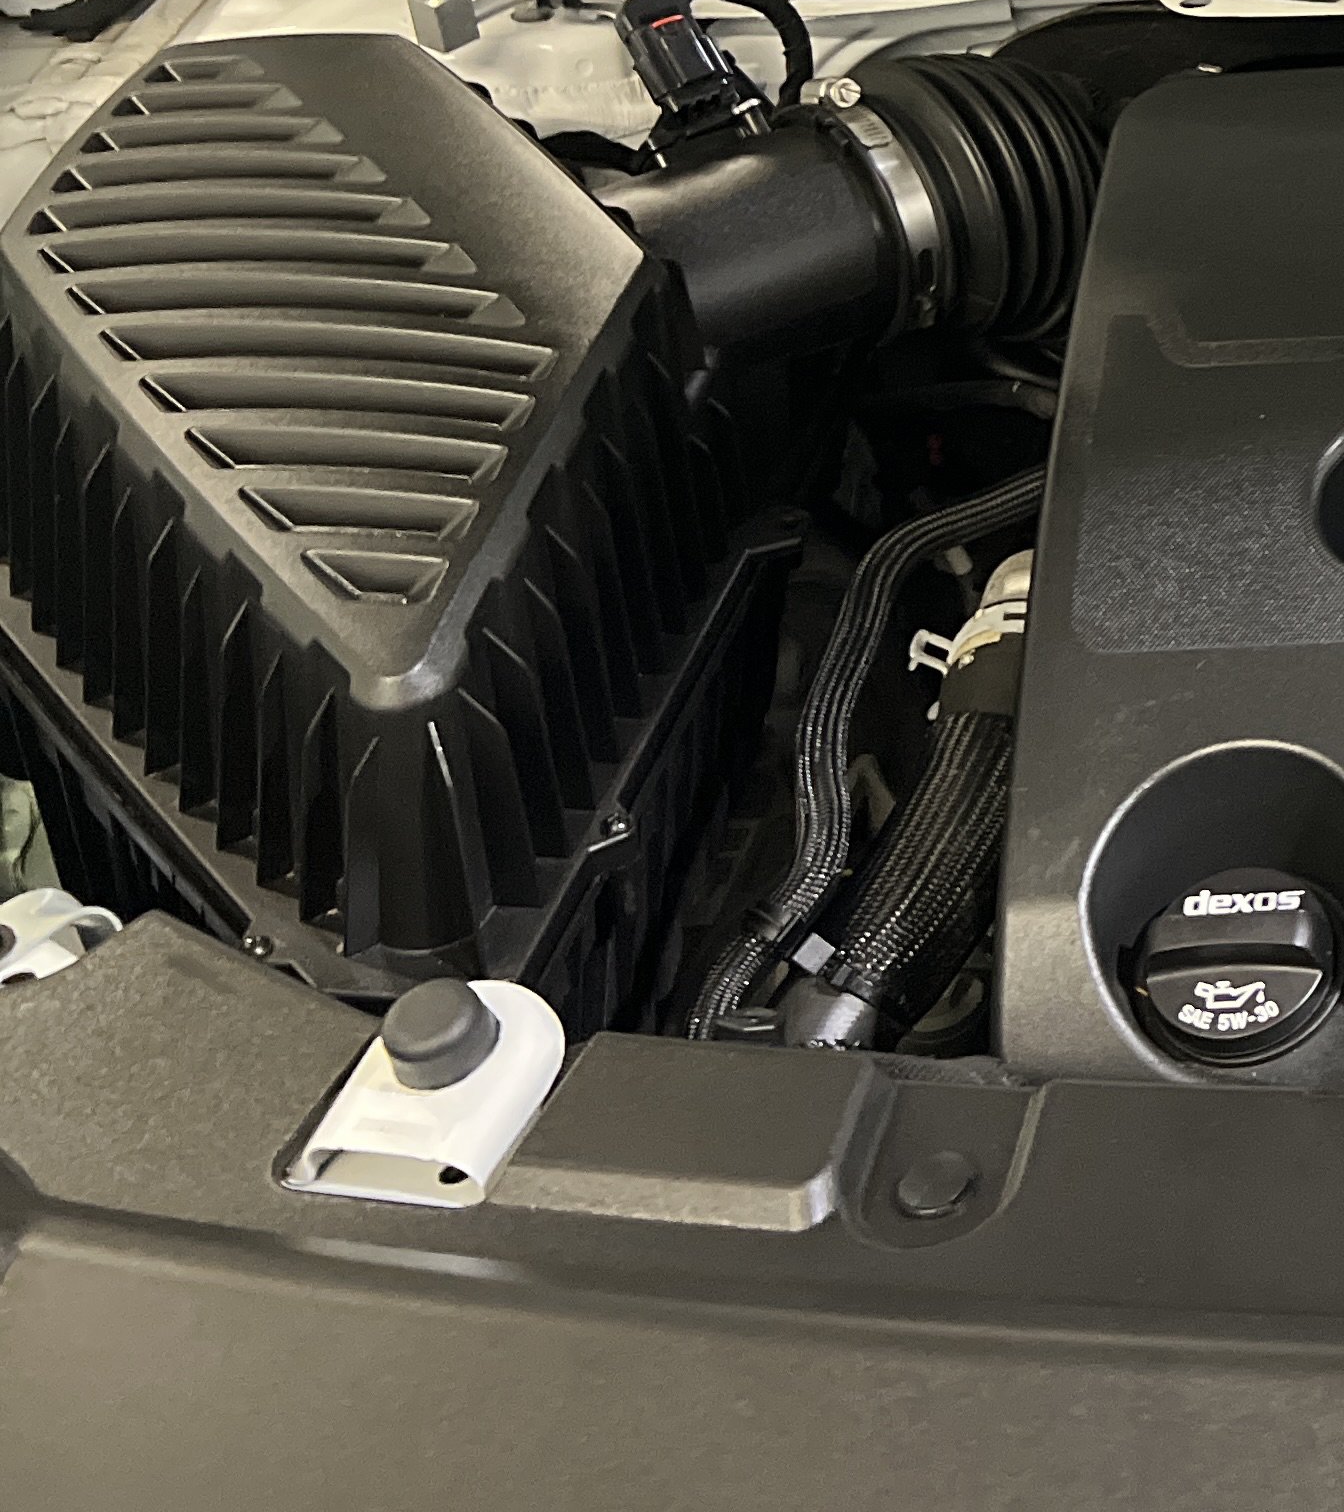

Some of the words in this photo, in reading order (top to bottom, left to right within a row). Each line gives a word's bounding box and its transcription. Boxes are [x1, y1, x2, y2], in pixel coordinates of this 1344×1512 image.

[1183, 889, 1306, 916] dexos
[1177, 1003, 1215, 1030] SAE
[1217, 1000, 1280, 1031] 5W-30
